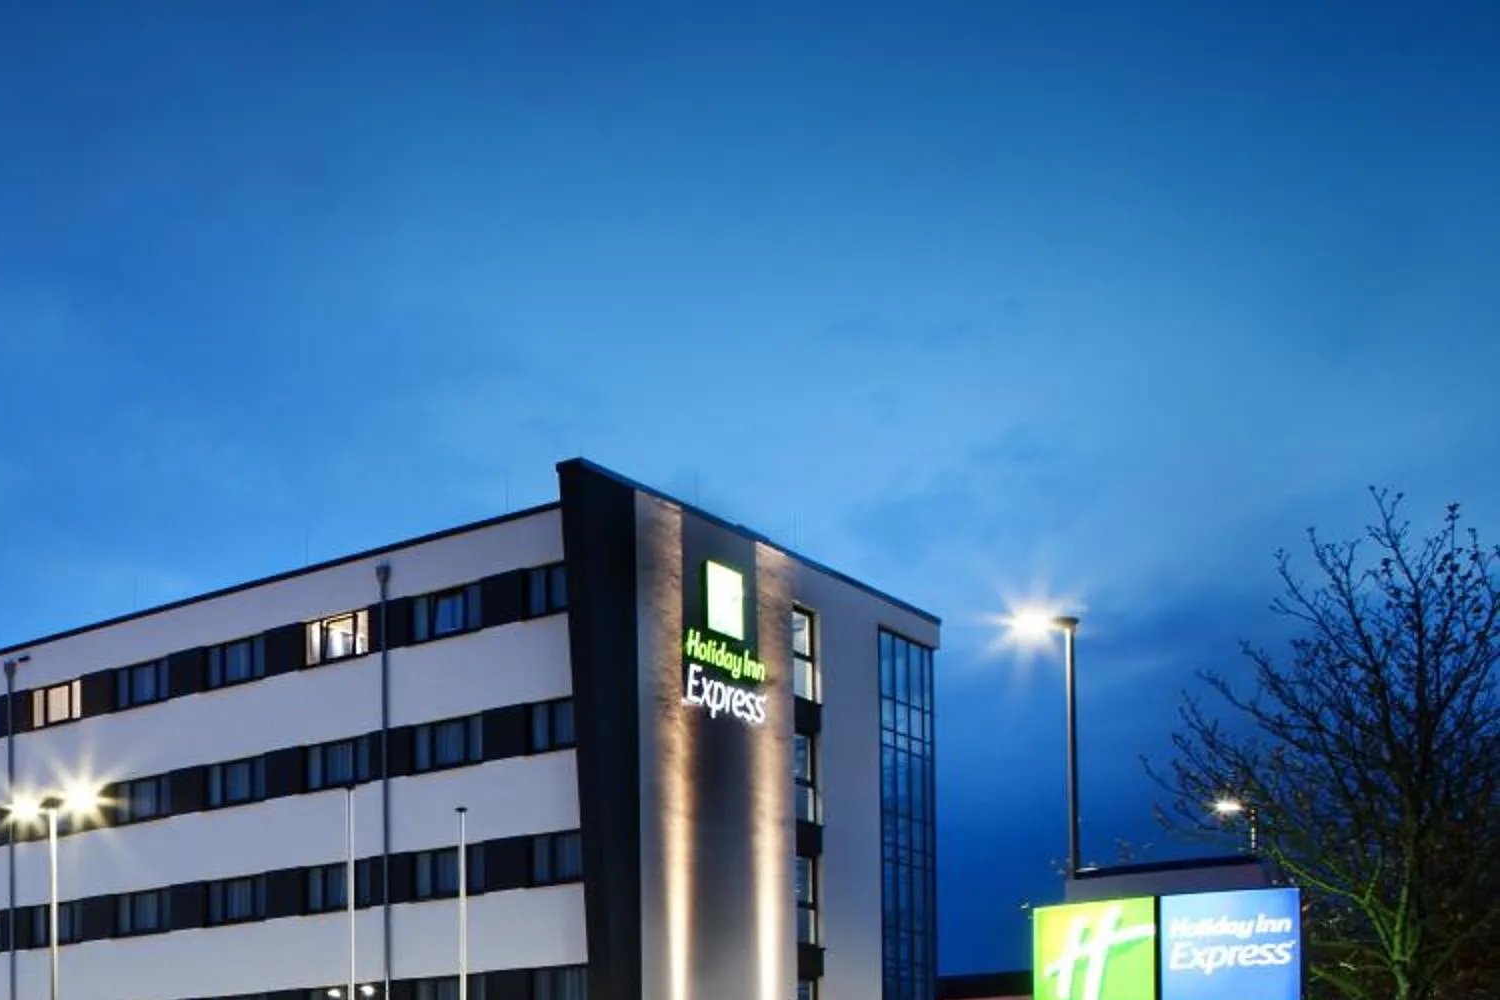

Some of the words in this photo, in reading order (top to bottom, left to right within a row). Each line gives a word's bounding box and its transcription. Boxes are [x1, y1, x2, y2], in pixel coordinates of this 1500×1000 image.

[686, 628, 742, 679] Holiday
[743, 649, 765, 681] Inn
[686, 663, 767, 723] Express
[1168, 916, 1253, 939] Holiday
[1255, 913, 1292, 933] Inn
[1169, 940, 1294, 975] Express
